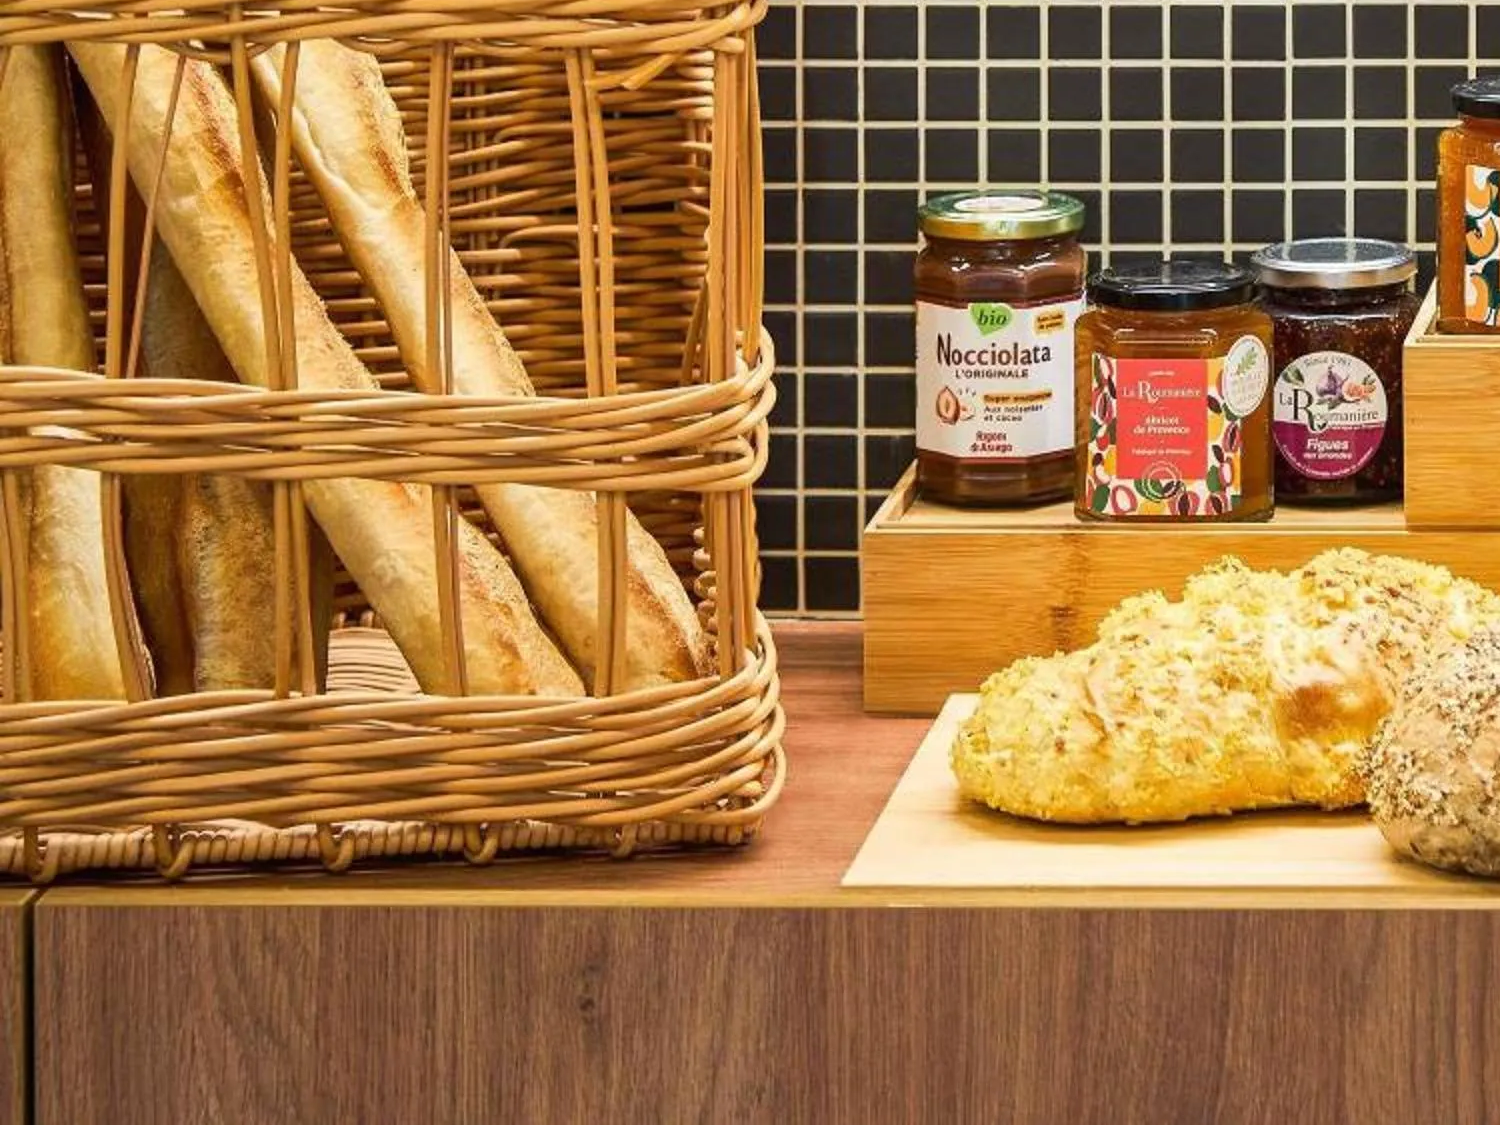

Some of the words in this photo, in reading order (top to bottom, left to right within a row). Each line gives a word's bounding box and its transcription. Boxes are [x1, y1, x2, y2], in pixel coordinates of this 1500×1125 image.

[978, 309, 1008, 326] bio
[937, 332, 1052, 367] Nocciolata
[955, 369, 1029, 380] L'ORIGINALE
[1279, 392, 1293, 406] La
[1133, 426, 1146, 434] de
[1147, 425, 1191, 435] Provence
[1306, 437, 1350, 452] Figues
